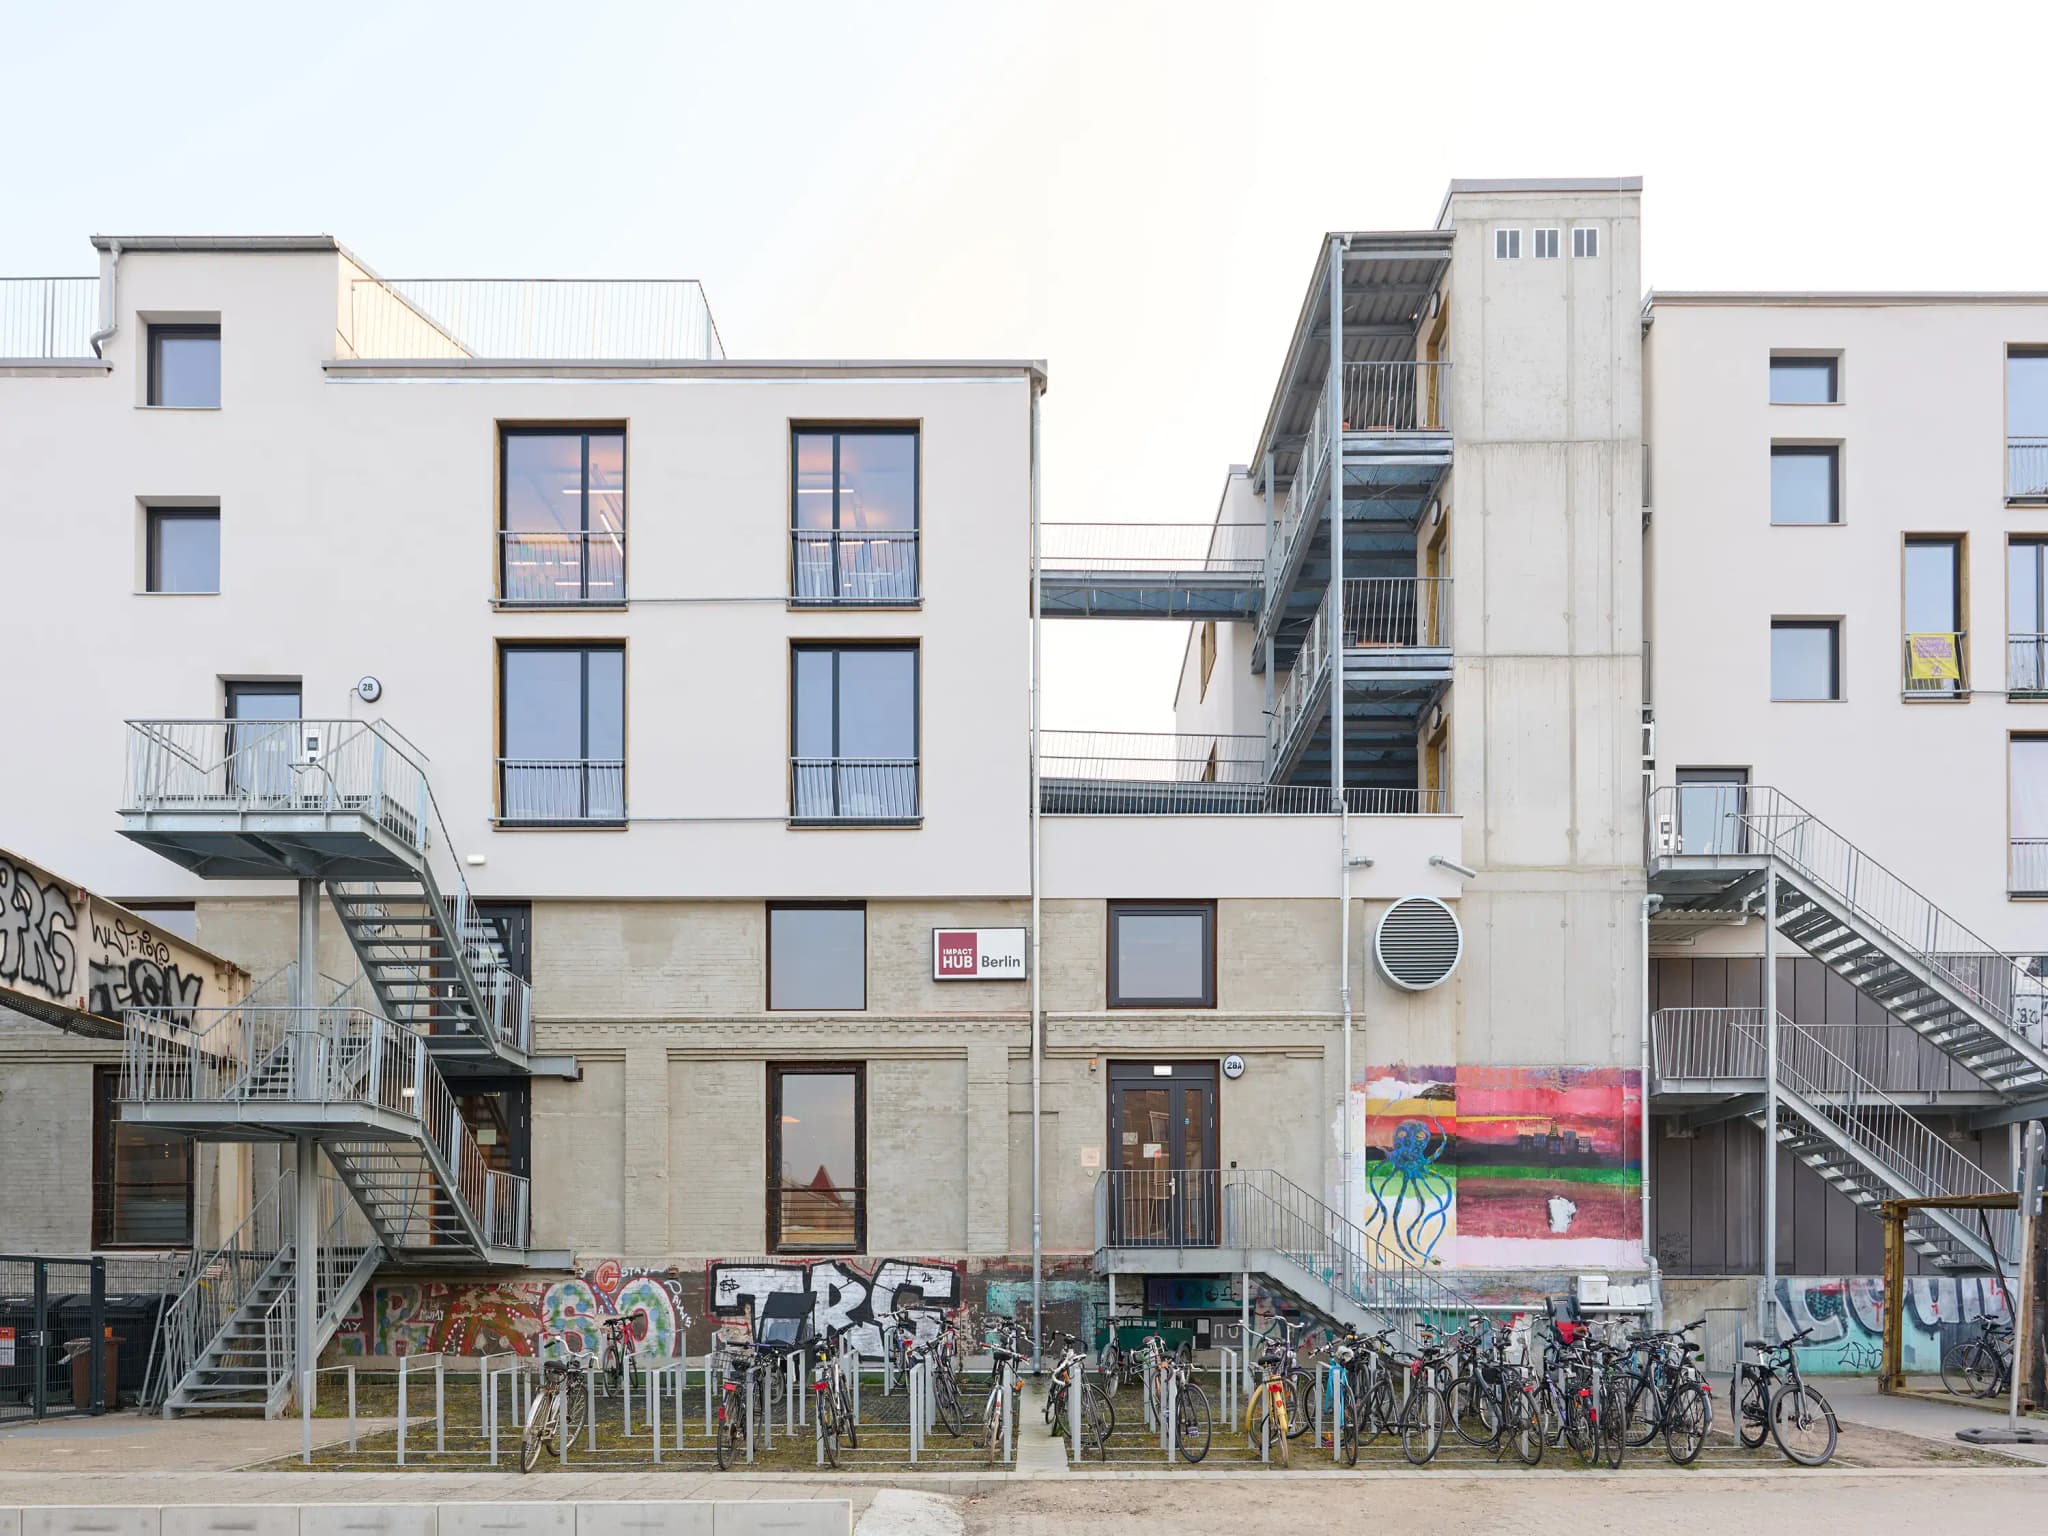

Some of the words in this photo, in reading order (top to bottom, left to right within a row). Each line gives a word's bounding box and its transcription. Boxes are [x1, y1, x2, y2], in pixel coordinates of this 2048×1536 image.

[363, 683, 373, 691] 28
[943, 956, 973, 969] HUB
[981, 955, 1020, 968] Berlin
[1227, 1061, 1242, 1070] 28A
